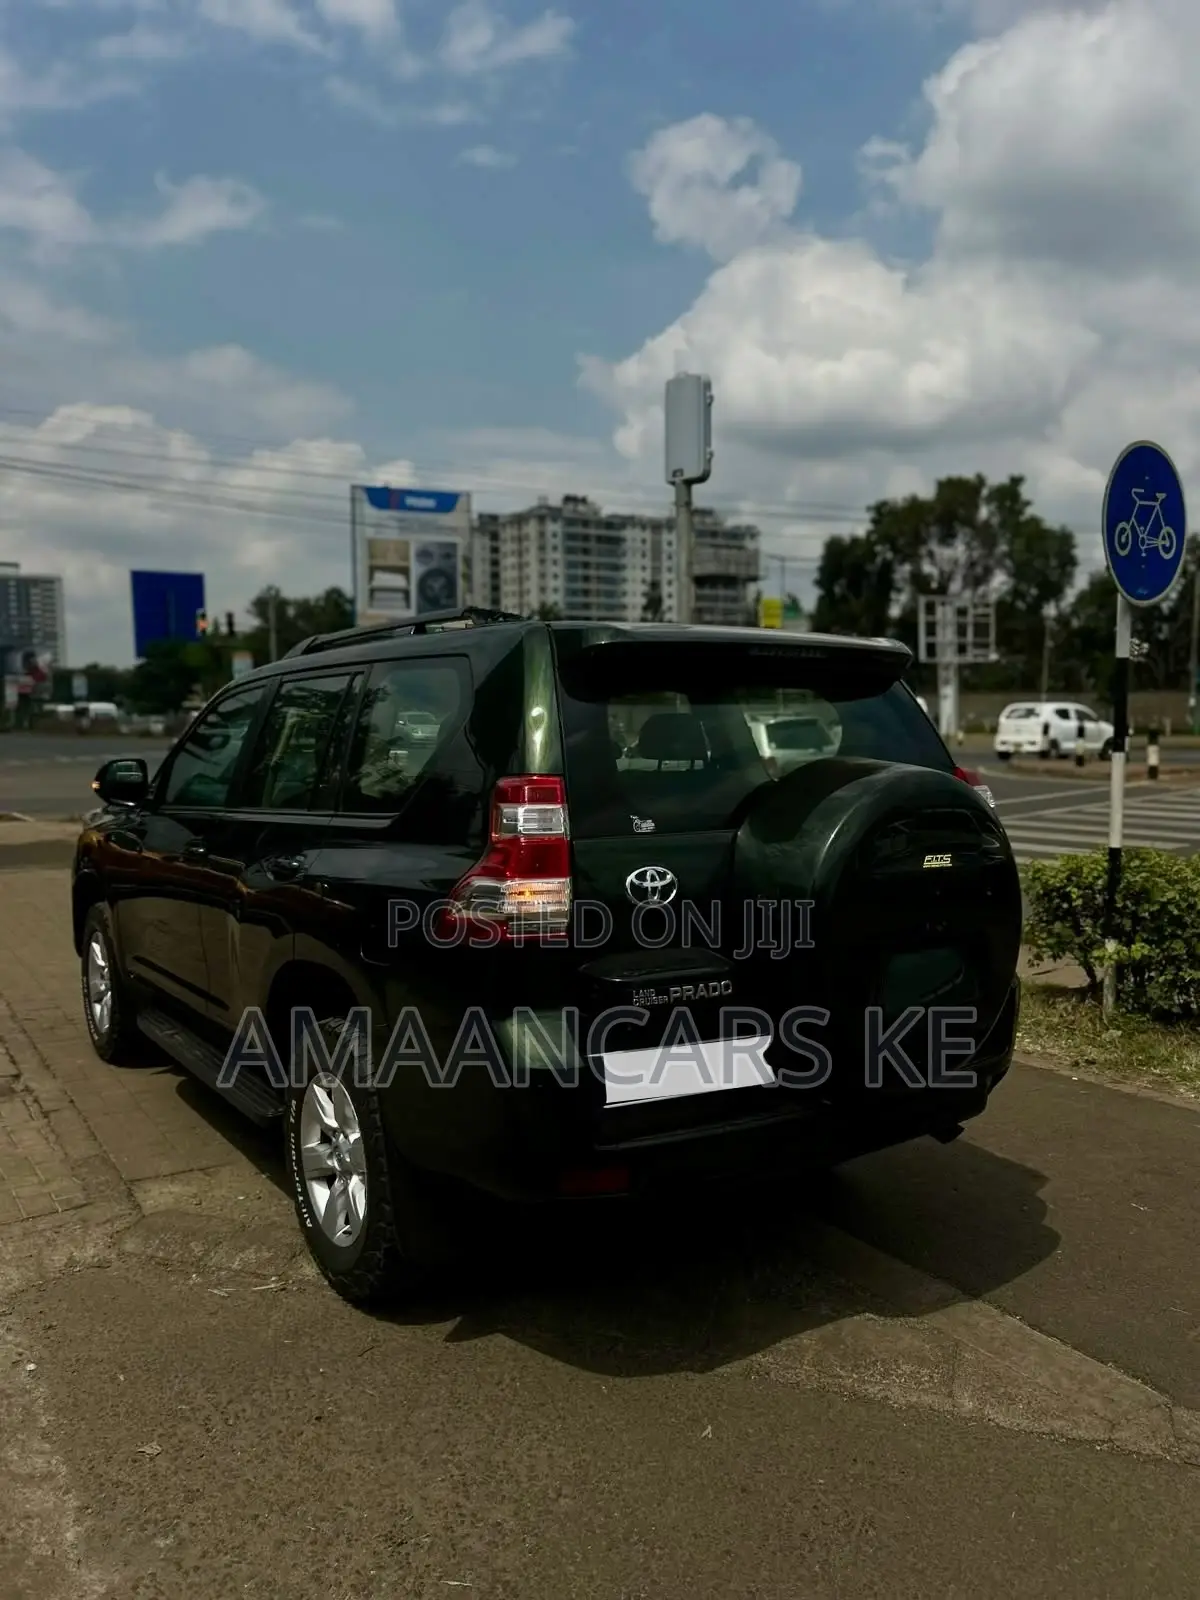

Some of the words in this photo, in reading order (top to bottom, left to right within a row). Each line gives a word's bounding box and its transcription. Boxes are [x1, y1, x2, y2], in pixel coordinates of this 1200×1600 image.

[632, 989, 656, 998] LAND
[669, 980, 733, 1003] PRADO
[632, 996, 669, 1006] CRUISER
